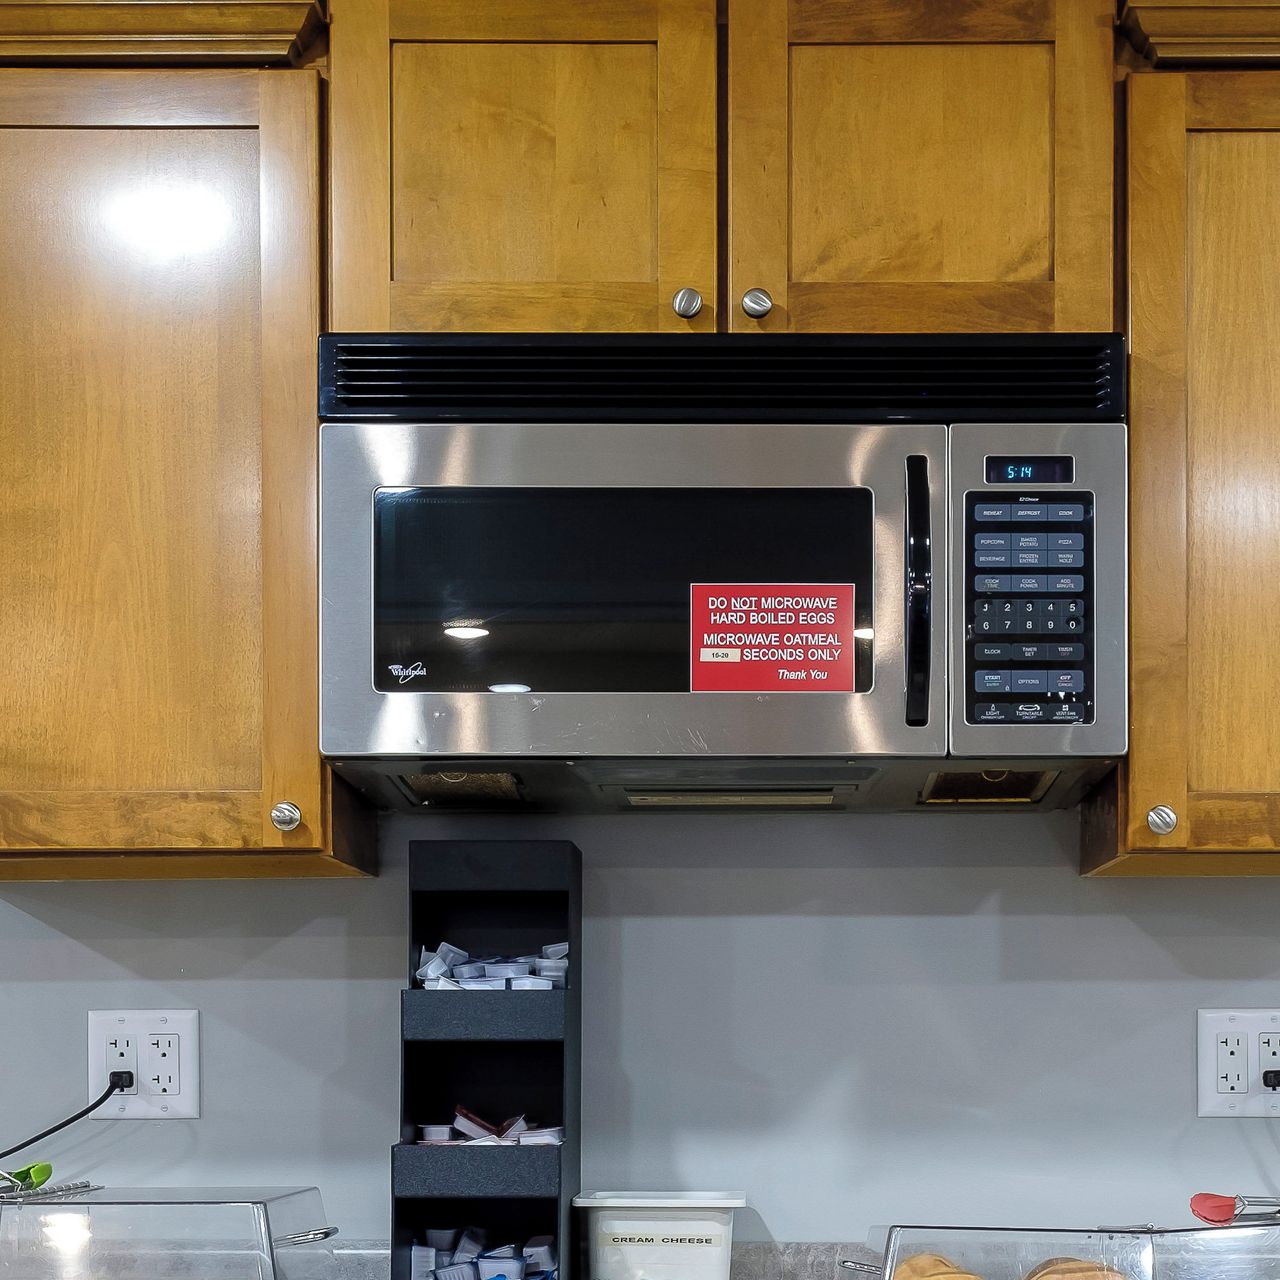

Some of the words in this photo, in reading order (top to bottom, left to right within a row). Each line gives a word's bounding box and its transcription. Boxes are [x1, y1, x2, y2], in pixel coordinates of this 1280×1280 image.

[1007, 465, 1032, 478] 5:14
[709, 597, 727, 609] DO
[731, 597, 758, 611] NOT
[761, 597, 838, 609] MICROWAVE
[1004, 603, 1011, 612] 2
[1026, 603, 1033, 612] 3
[1047, 603, 1054, 612] 4
[1069, 603, 1076, 612] 5
[710, 612, 746, 625] HARD
[749, 612, 796, 625] BOILED
[799, 612, 836, 625] EGGS
[983, 621, 990, 630] 6
[1004, 621, 1011, 630] 7
[1026, 621, 1033, 630] 8
[1047, 621, 1054, 630] 9
[1069, 621, 1076, 630] 0
[703, 633, 780, 646] MICROWAVE
[783, 633, 842, 646] OATMEAL
[742, 648, 805, 661] SECONDS
[808, 648, 842, 661] ONLY
[778, 669, 808, 680] Thank
[809, 669, 828, 680] You
[661, 1237, 713, 1245] CHEESE
